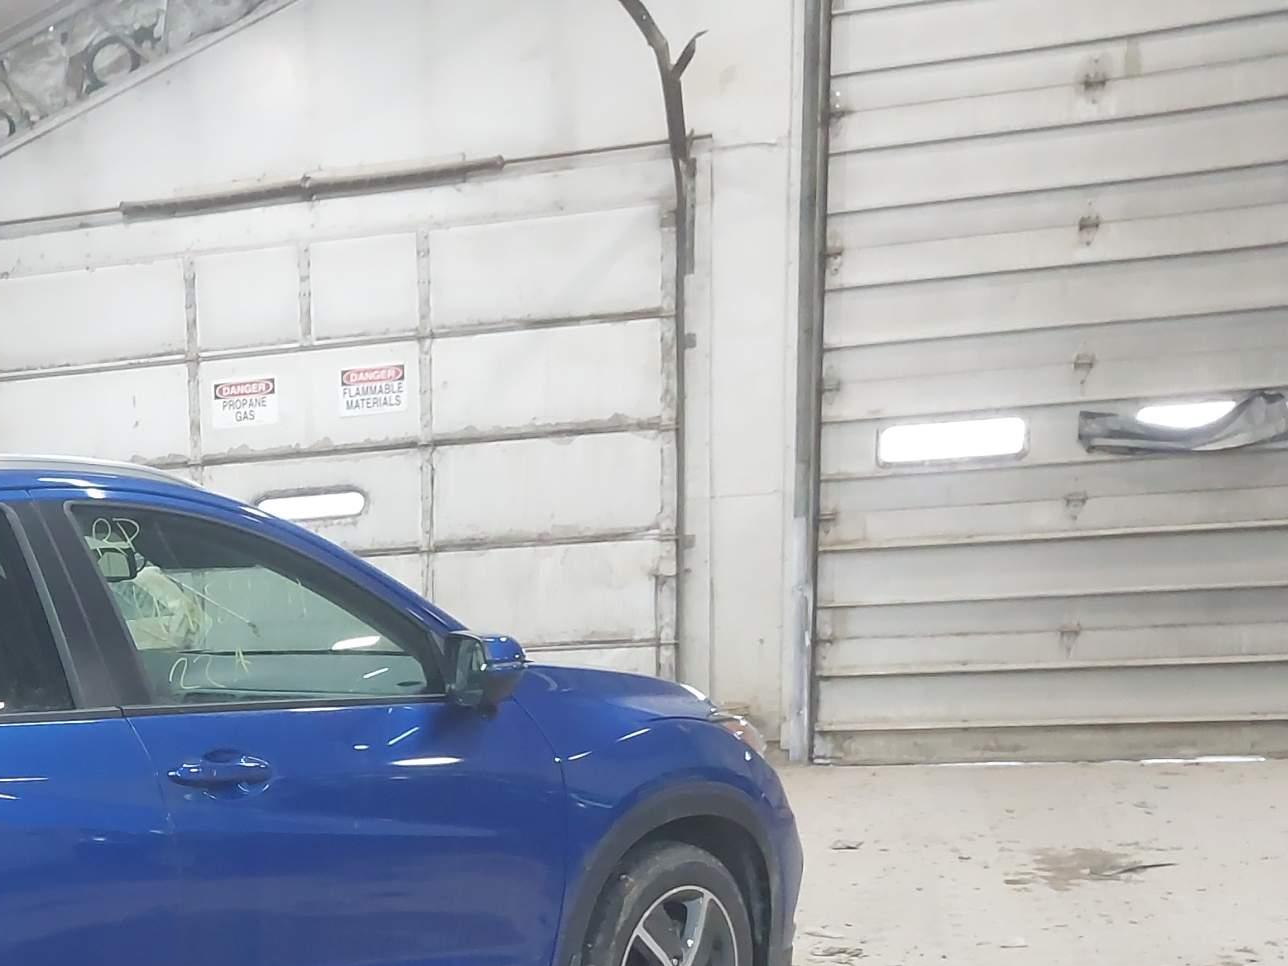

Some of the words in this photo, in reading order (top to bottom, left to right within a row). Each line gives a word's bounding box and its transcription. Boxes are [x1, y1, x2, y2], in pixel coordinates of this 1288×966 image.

[349, 368, 395, 383] DANGER
[222, 382, 266, 396] DANGER
[342, 382, 404, 399] FLAMMABLE
[222, 396, 267, 411] PROPANE
[345, 394, 402, 410] MATERIALS
[235, 410, 255, 422] GAS
